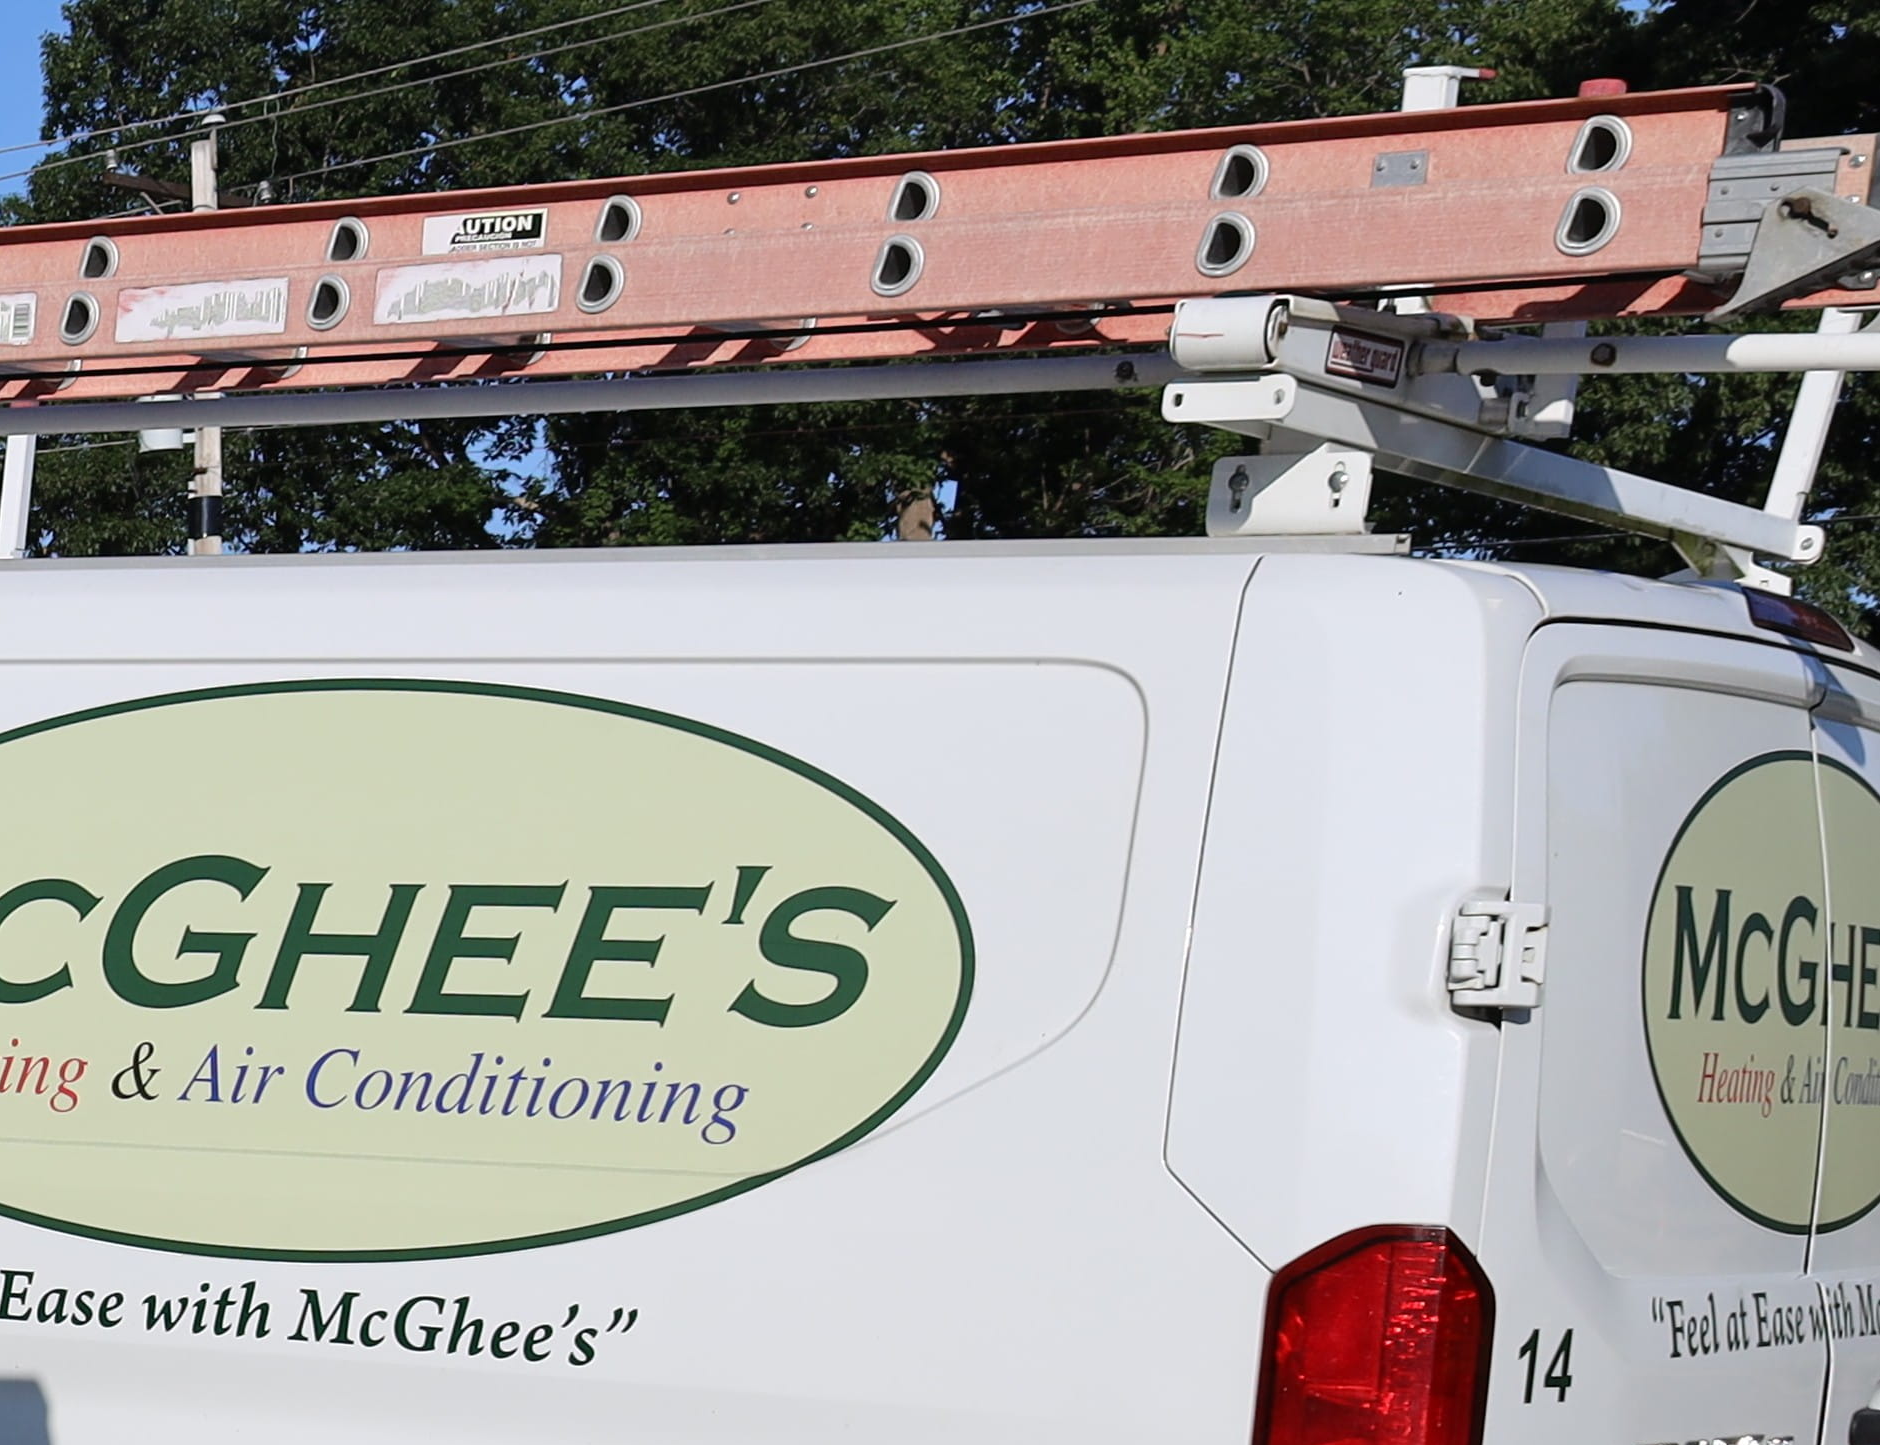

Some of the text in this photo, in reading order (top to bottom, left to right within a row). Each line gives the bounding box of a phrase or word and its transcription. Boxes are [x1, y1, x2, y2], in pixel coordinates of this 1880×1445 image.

[111, 1042, 161, 1101] &
[178, 1044, 284, 1108] Air
[305, 1048, 750, 1144] Conditioning
[1698, 1053, 1775, 1119] Heating
[1781, 1054, 1796, 1105] &
[142, 1279, 272, 1339] with
[1727, 1298, 1749, 1352] at
[1752, 1292, 1805, 1347] Ease
[1809, 1281, 1854, 1342] with
[1518, 1328, 1574, 1404] 14
